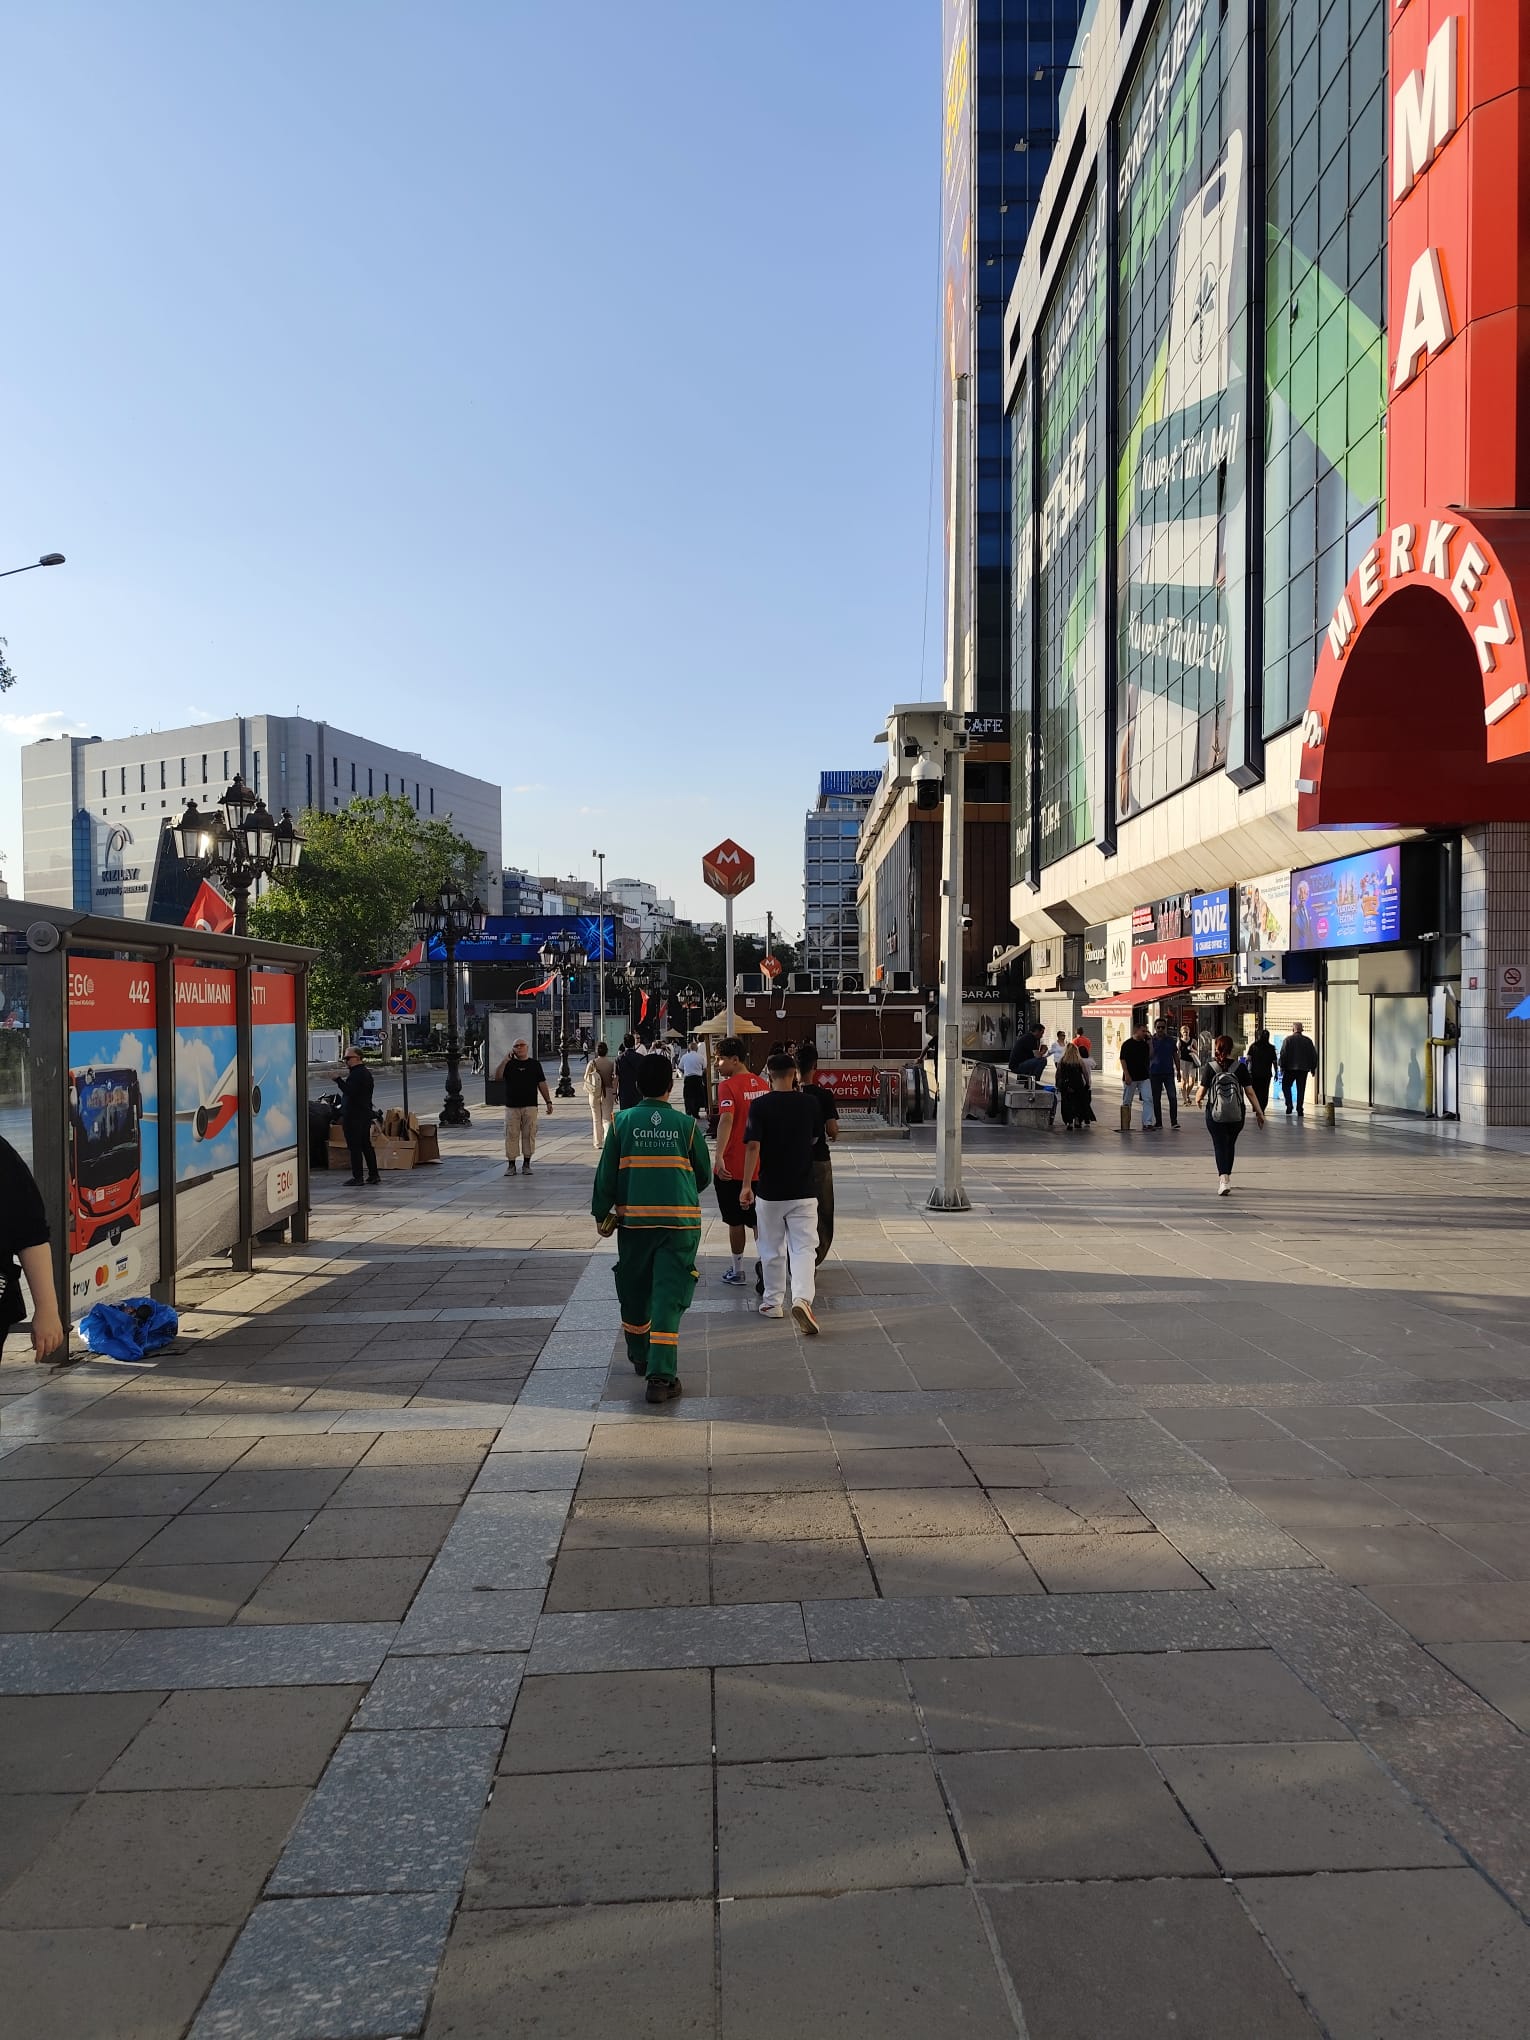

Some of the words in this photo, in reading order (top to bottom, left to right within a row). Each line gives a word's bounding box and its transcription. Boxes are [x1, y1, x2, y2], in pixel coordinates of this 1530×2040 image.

[1393, 0, 1461, 391] MA
[1142, 445, 1175, 494] Kuveyt
[1328, 519, 1527, 727] MERKEZİ
[716, 849, 740, 864] M
[1195, 897, 1228, 935] DÖVİZ
[1174, 959, 1188, 983] $
[129, 980, 150, 1003] 442
[961, 990, 1000, 999] SARAR
[841, 1073, 871, 1083] Metro
[632, 1128, 679, 1139] Çankaya
[634, 1140, 679, 1148] BELEDİYESİ
